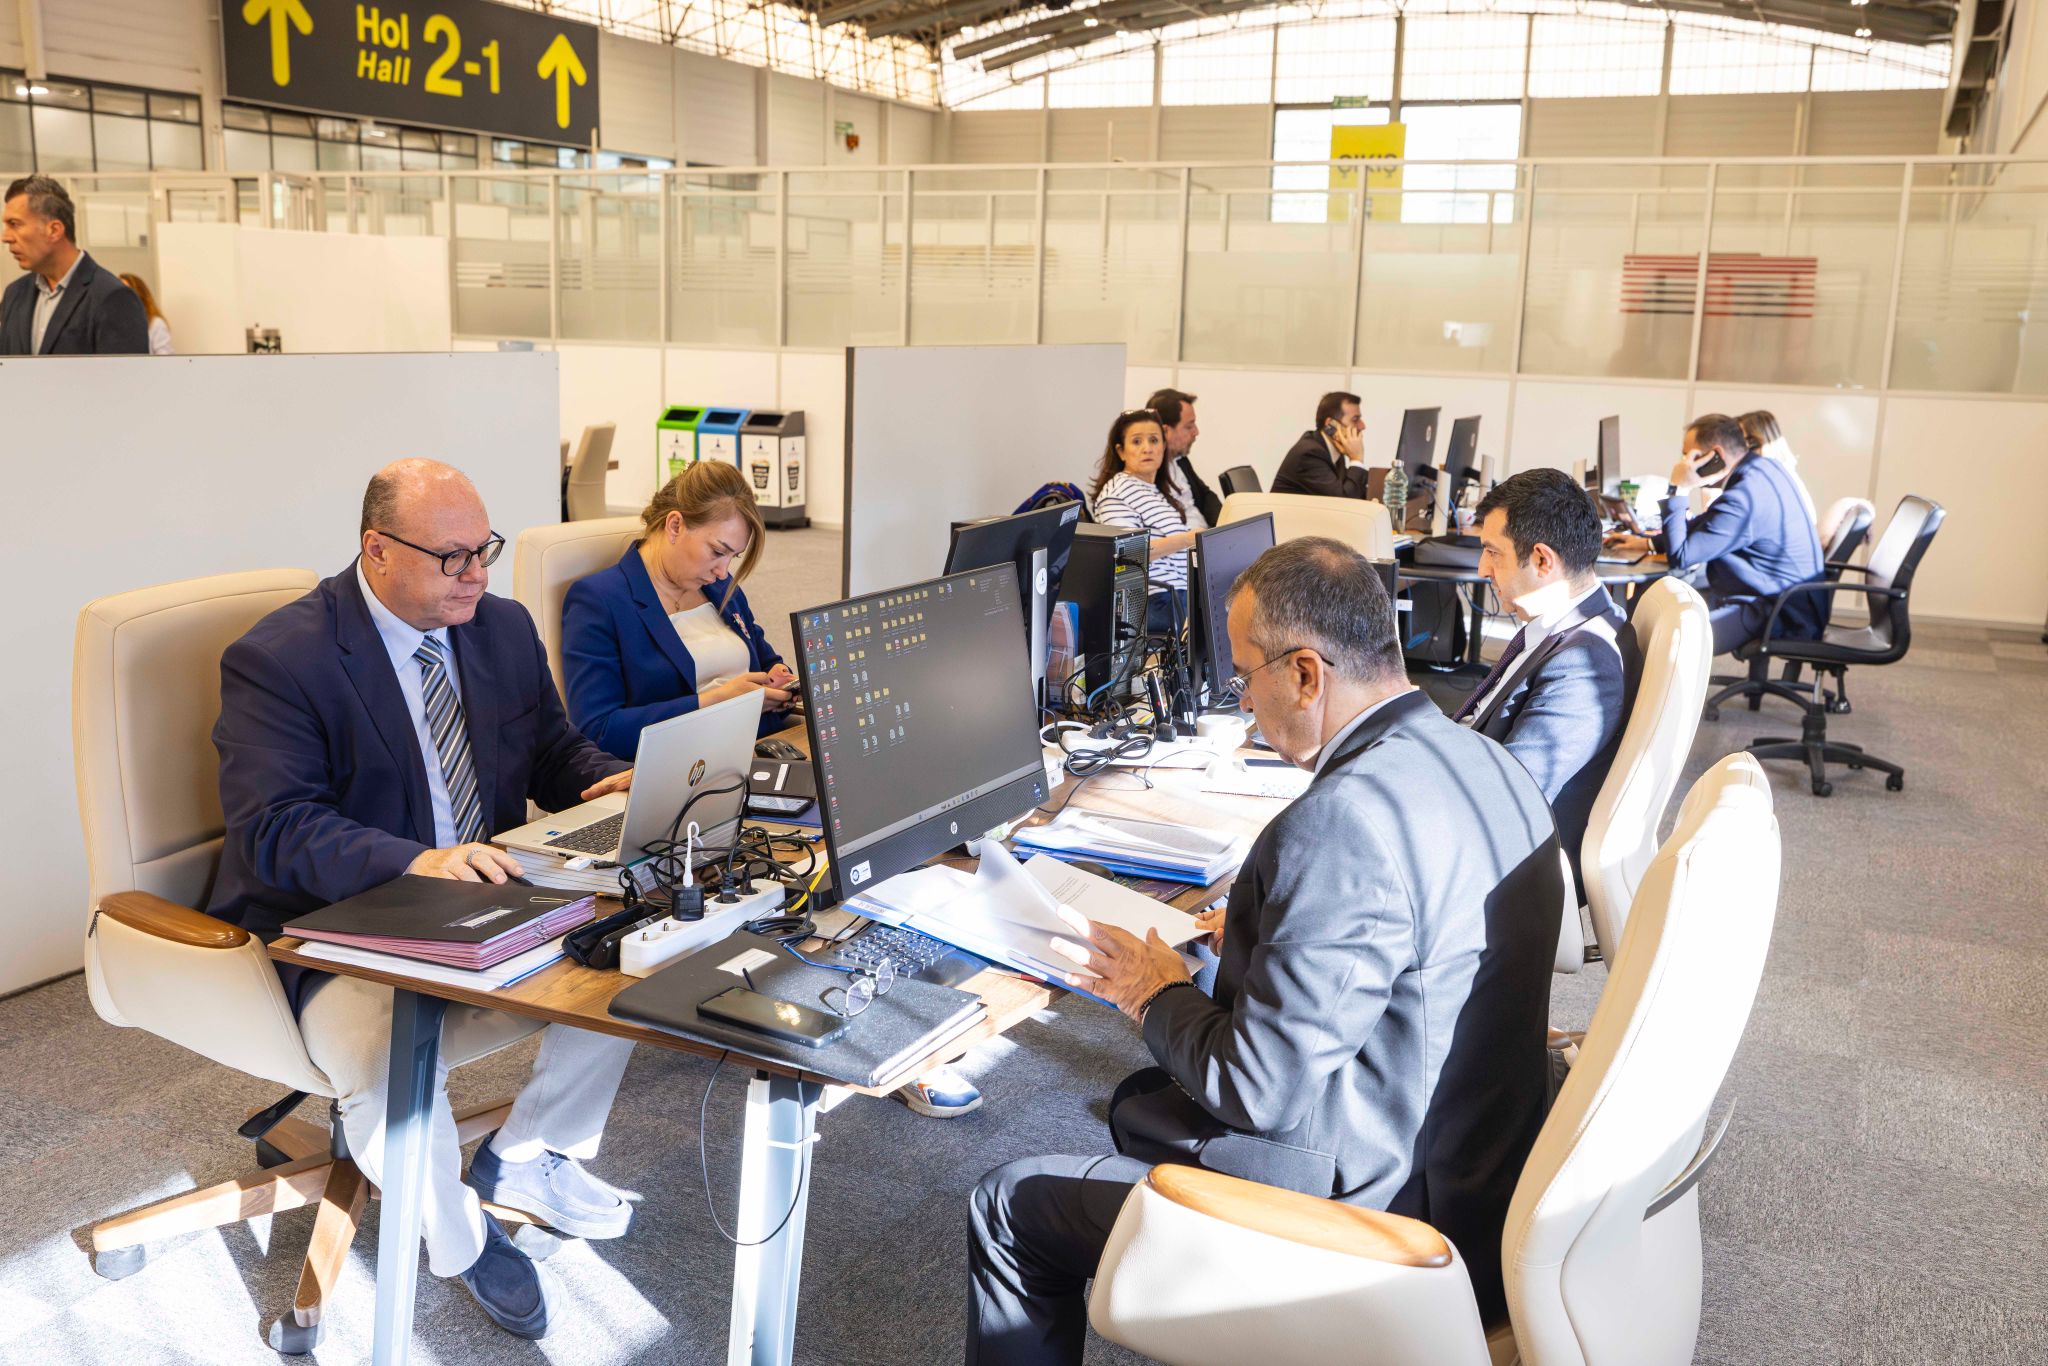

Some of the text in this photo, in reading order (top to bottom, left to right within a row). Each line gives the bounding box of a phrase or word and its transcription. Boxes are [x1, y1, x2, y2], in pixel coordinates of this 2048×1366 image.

[356, 3, 409, 51] Hol
[356, 49, 411, 86] Hall
[422, 13, 501, 97] 2-1
[688, 760, 705, 787] hp
